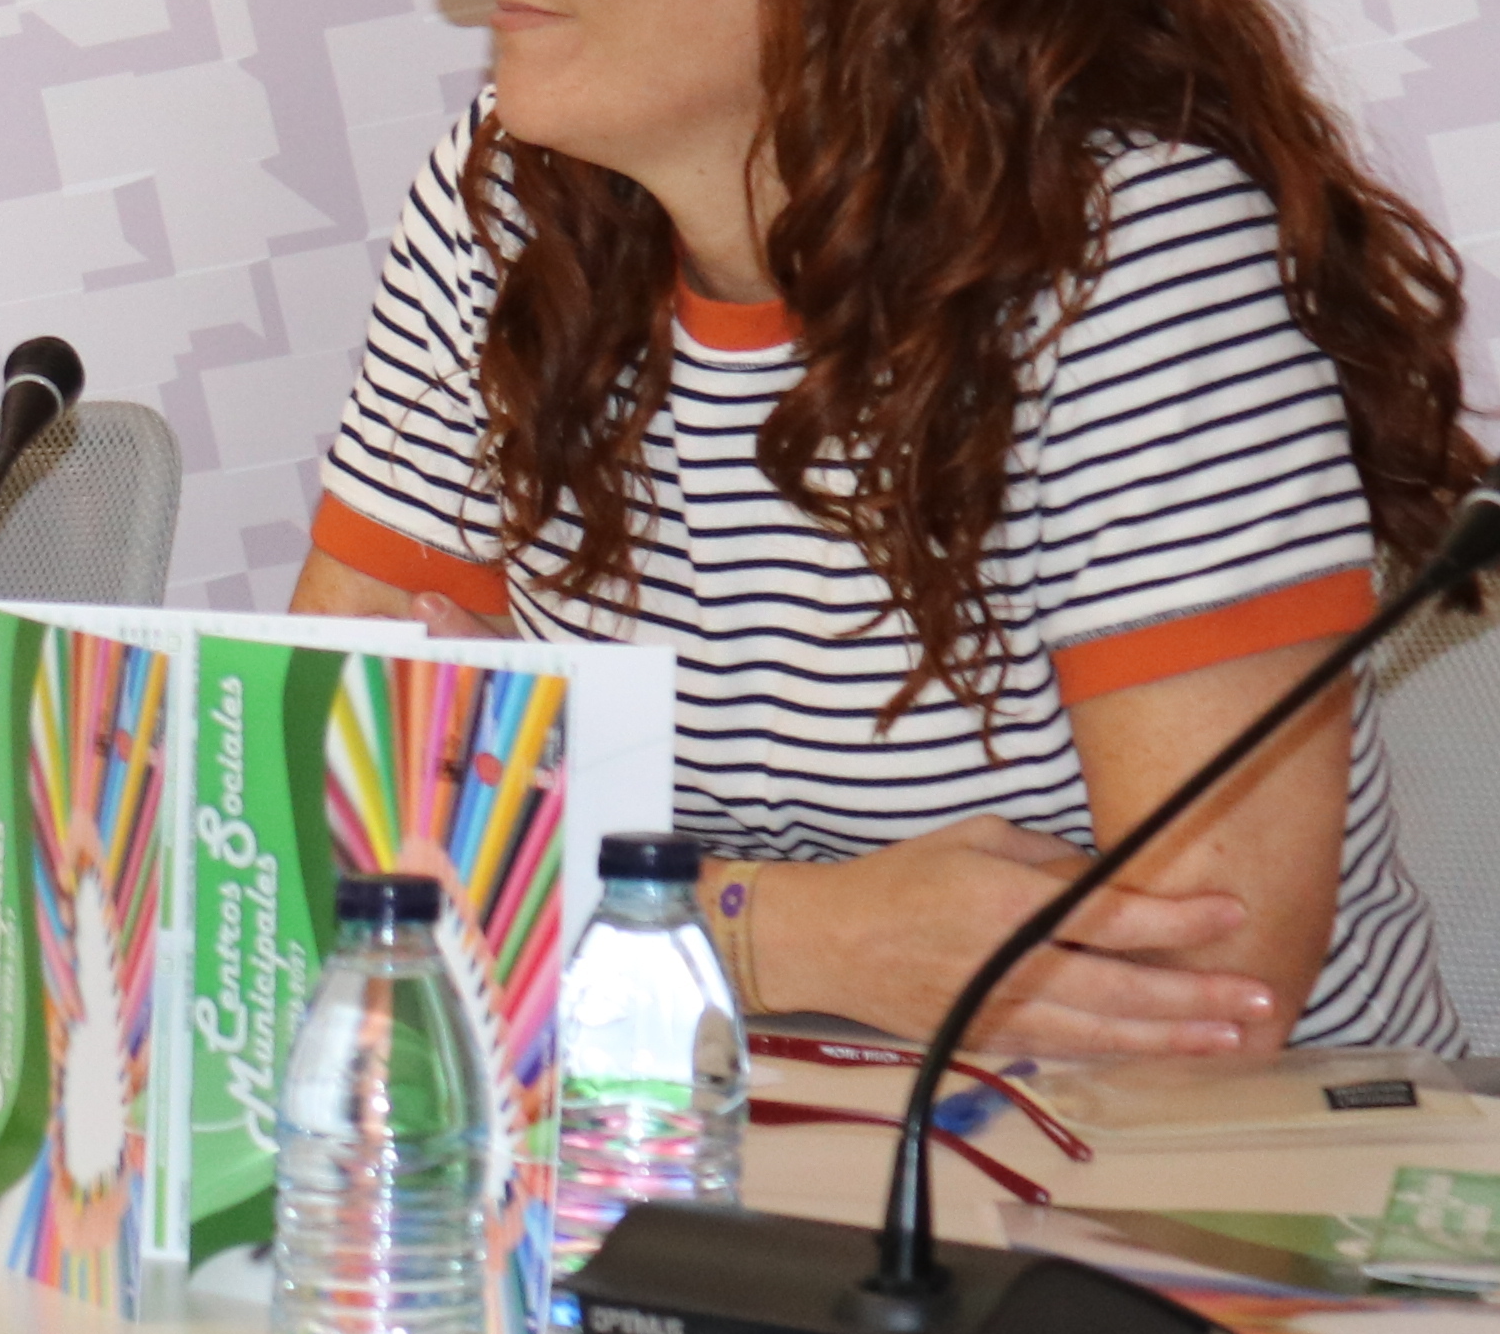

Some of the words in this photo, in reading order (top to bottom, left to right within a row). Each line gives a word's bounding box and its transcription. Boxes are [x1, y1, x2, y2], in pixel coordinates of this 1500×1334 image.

[196, 676, 256, 868] Sociales
[196, 880, 248, 1052] Centros
[231, 852, 287, 1152] Municipales
